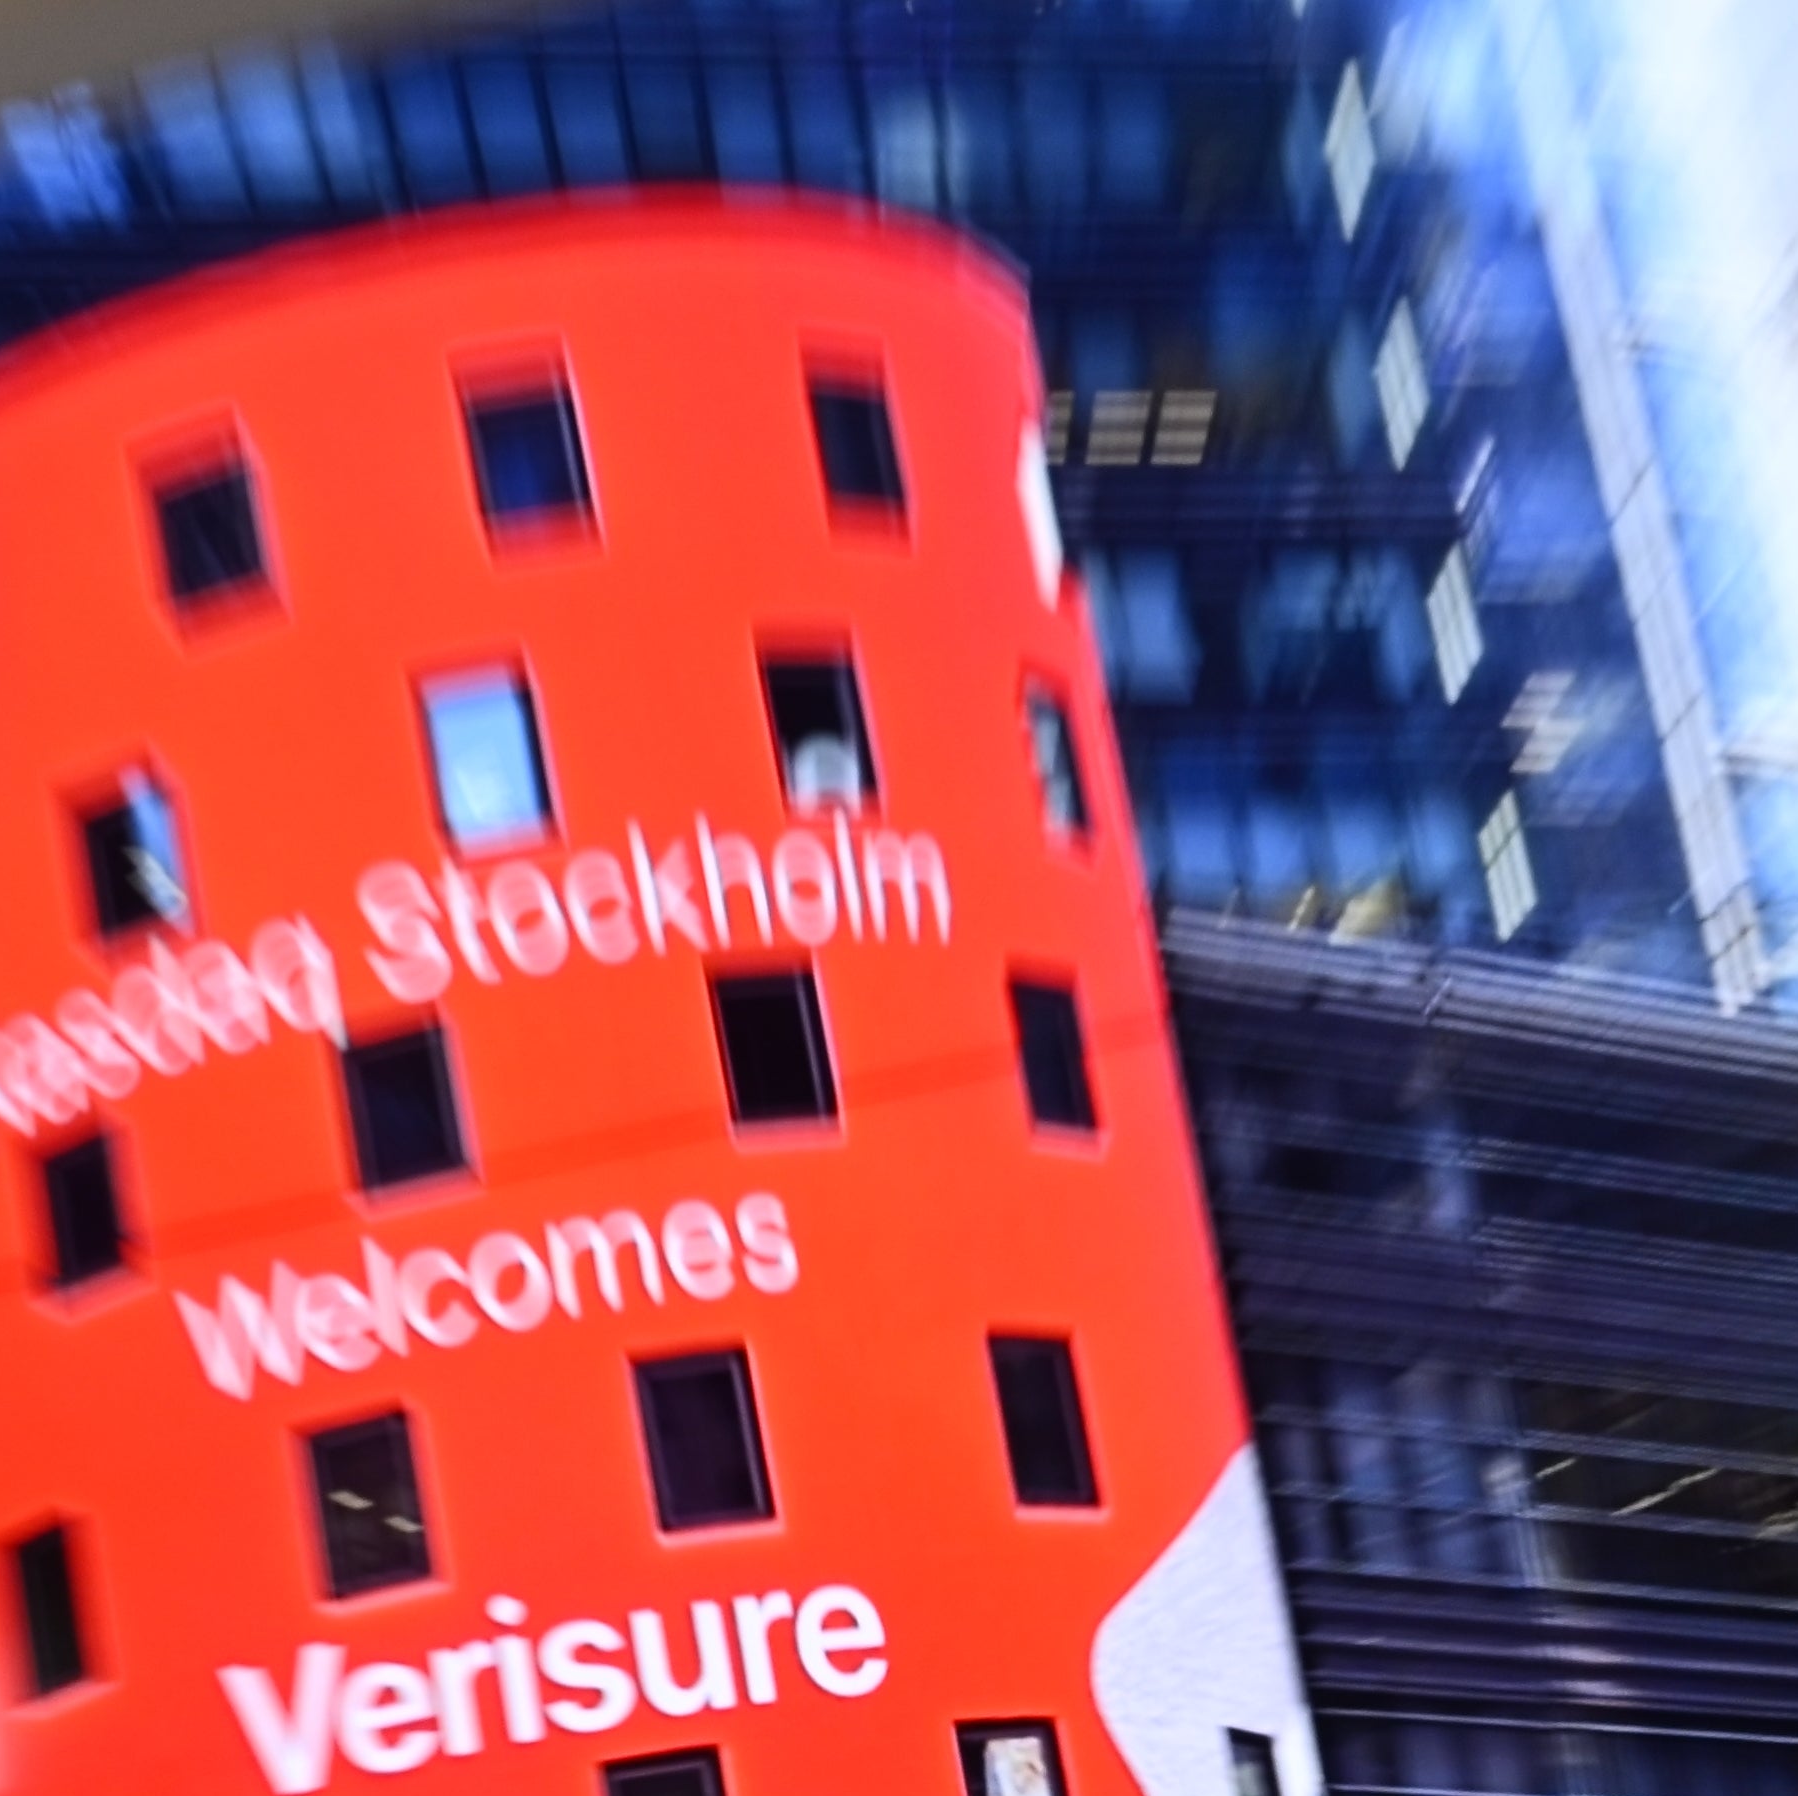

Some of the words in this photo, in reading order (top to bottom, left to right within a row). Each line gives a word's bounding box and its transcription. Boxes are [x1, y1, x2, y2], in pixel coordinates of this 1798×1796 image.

[355, 806, 953, 1002] Stockholm
[175, 1192, 800, 1400] Welcomes
[216, 1583, 889, 1795] Verisure
